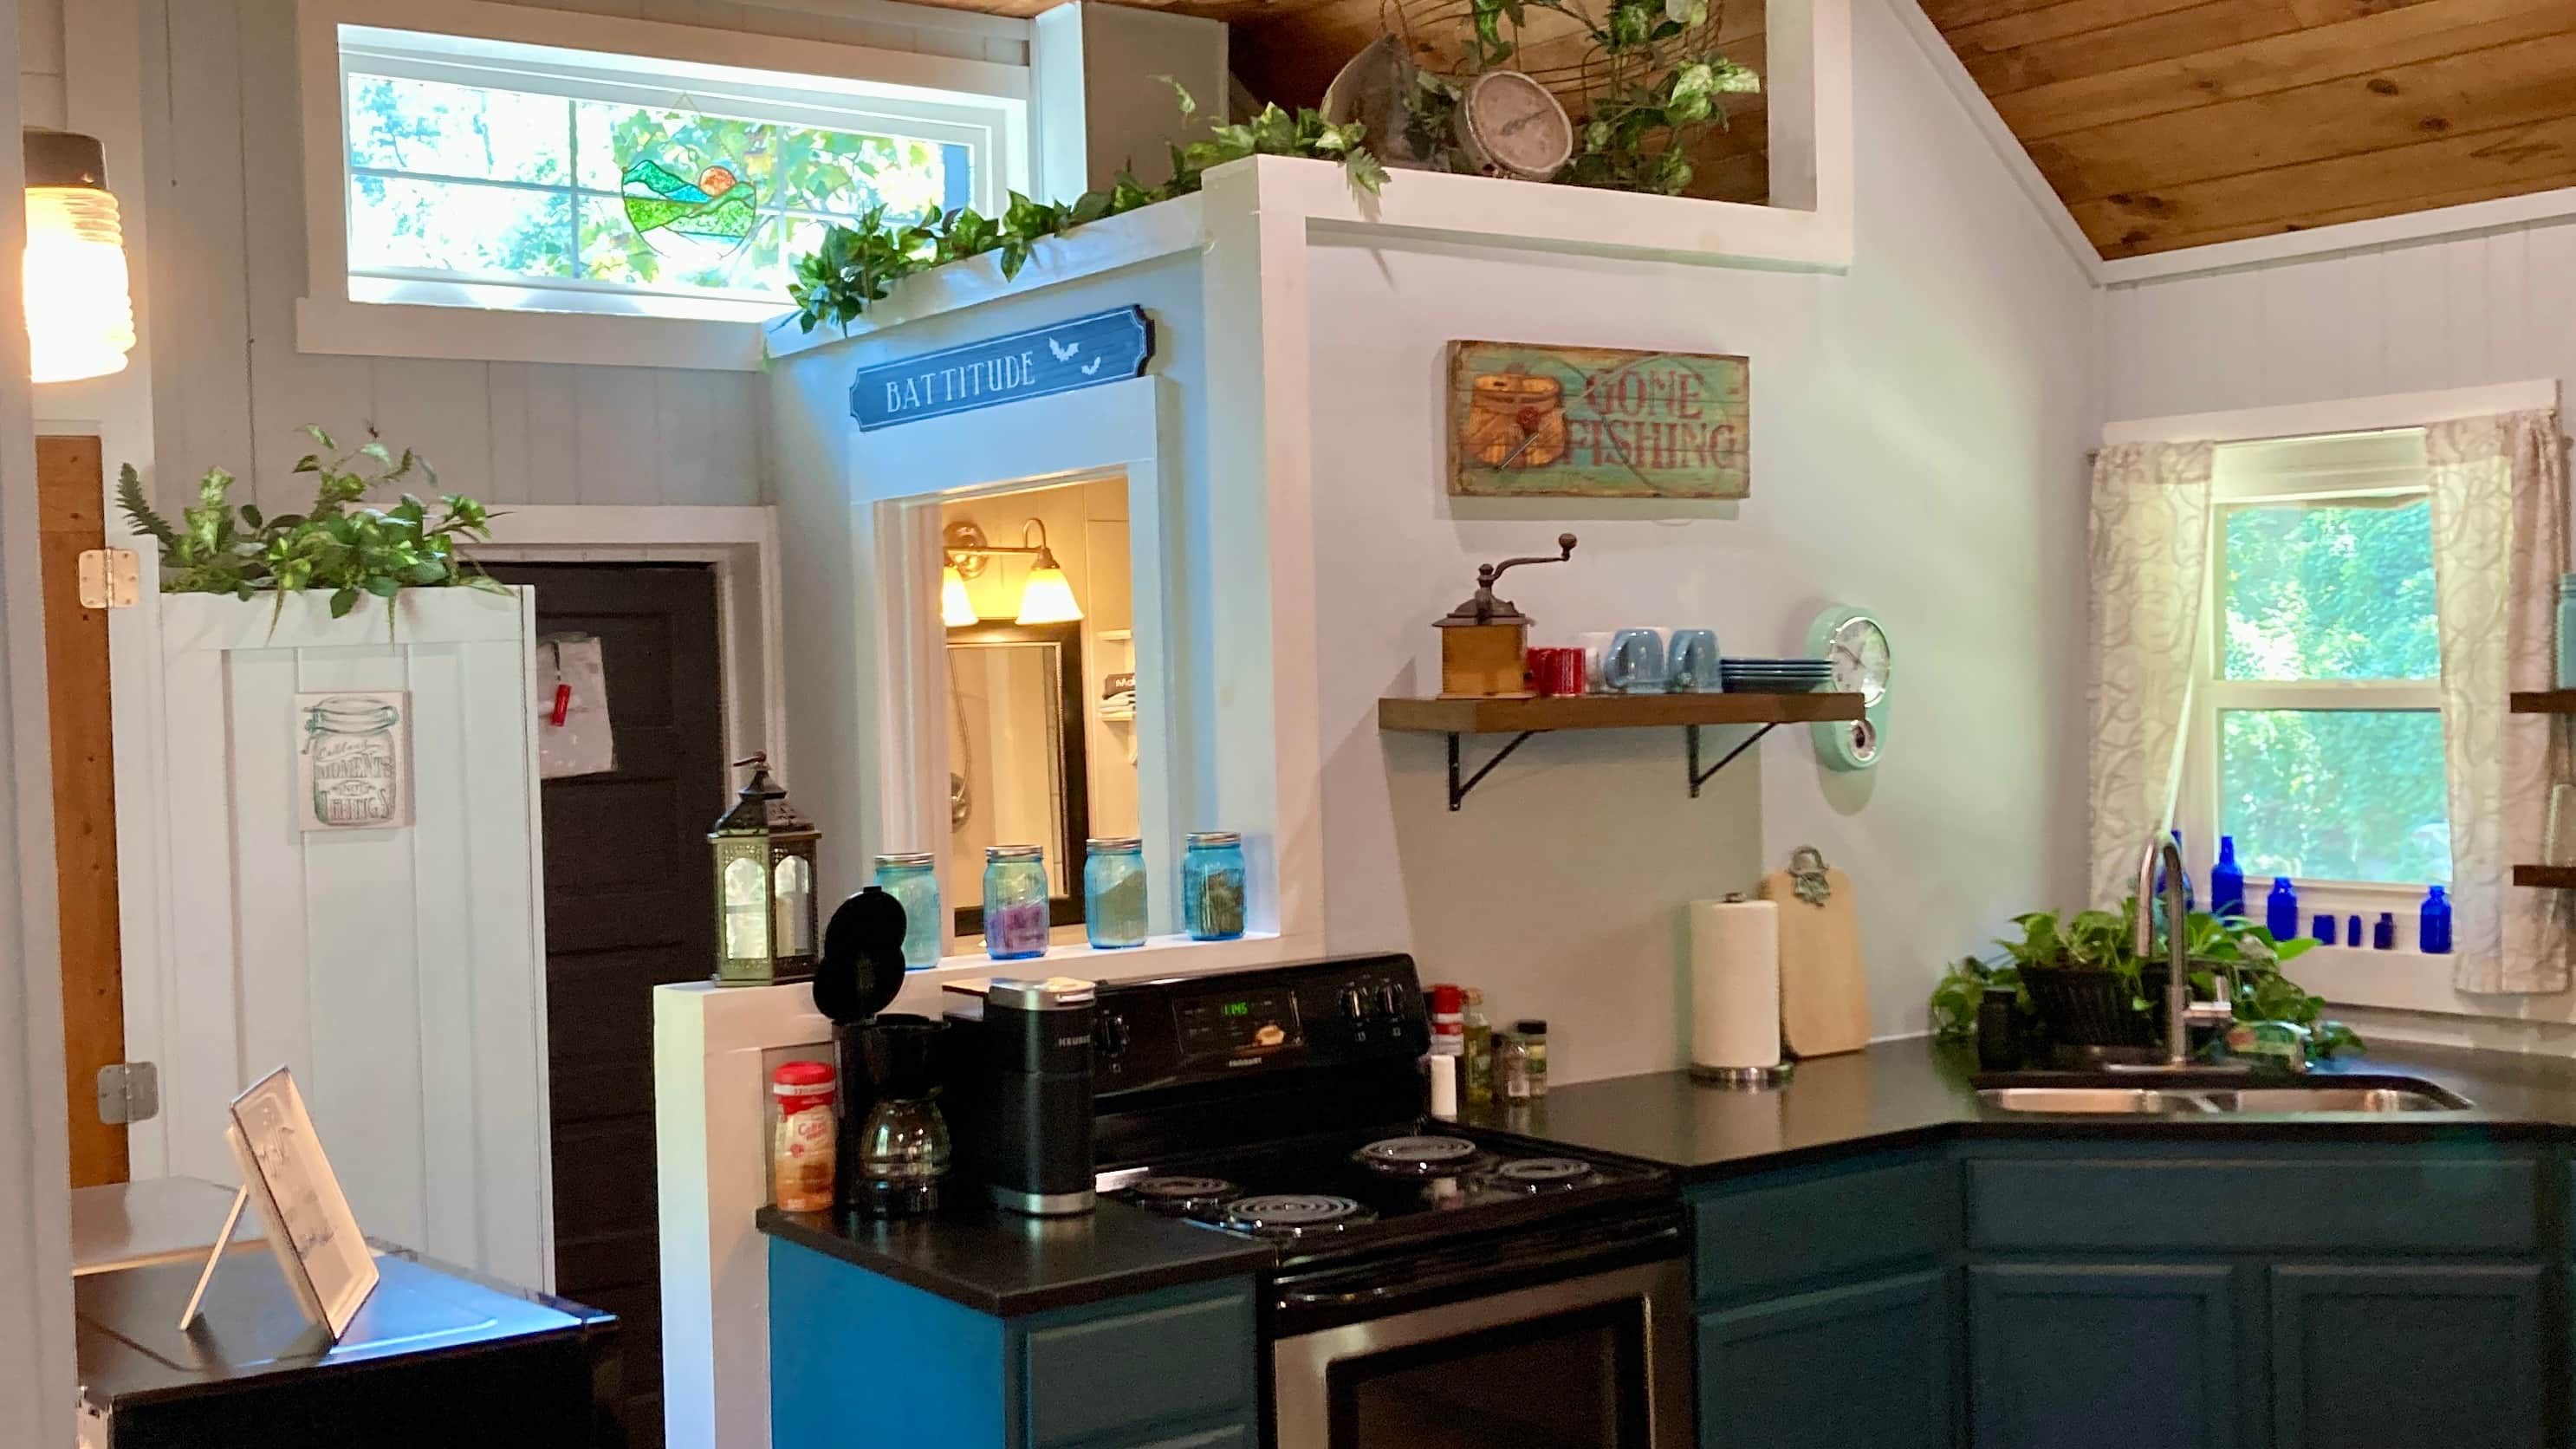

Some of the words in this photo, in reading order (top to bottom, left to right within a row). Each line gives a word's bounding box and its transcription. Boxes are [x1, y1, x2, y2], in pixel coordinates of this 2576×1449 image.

[886, 351, 1035, 413] BATTITUDE
[1585, 369, 1703, 419] GONE
[1564, 419, 1737, 469] FISHING
[317, 754, 395, 778] MOMENTS
[320, 788, 390, 820] THINGS
